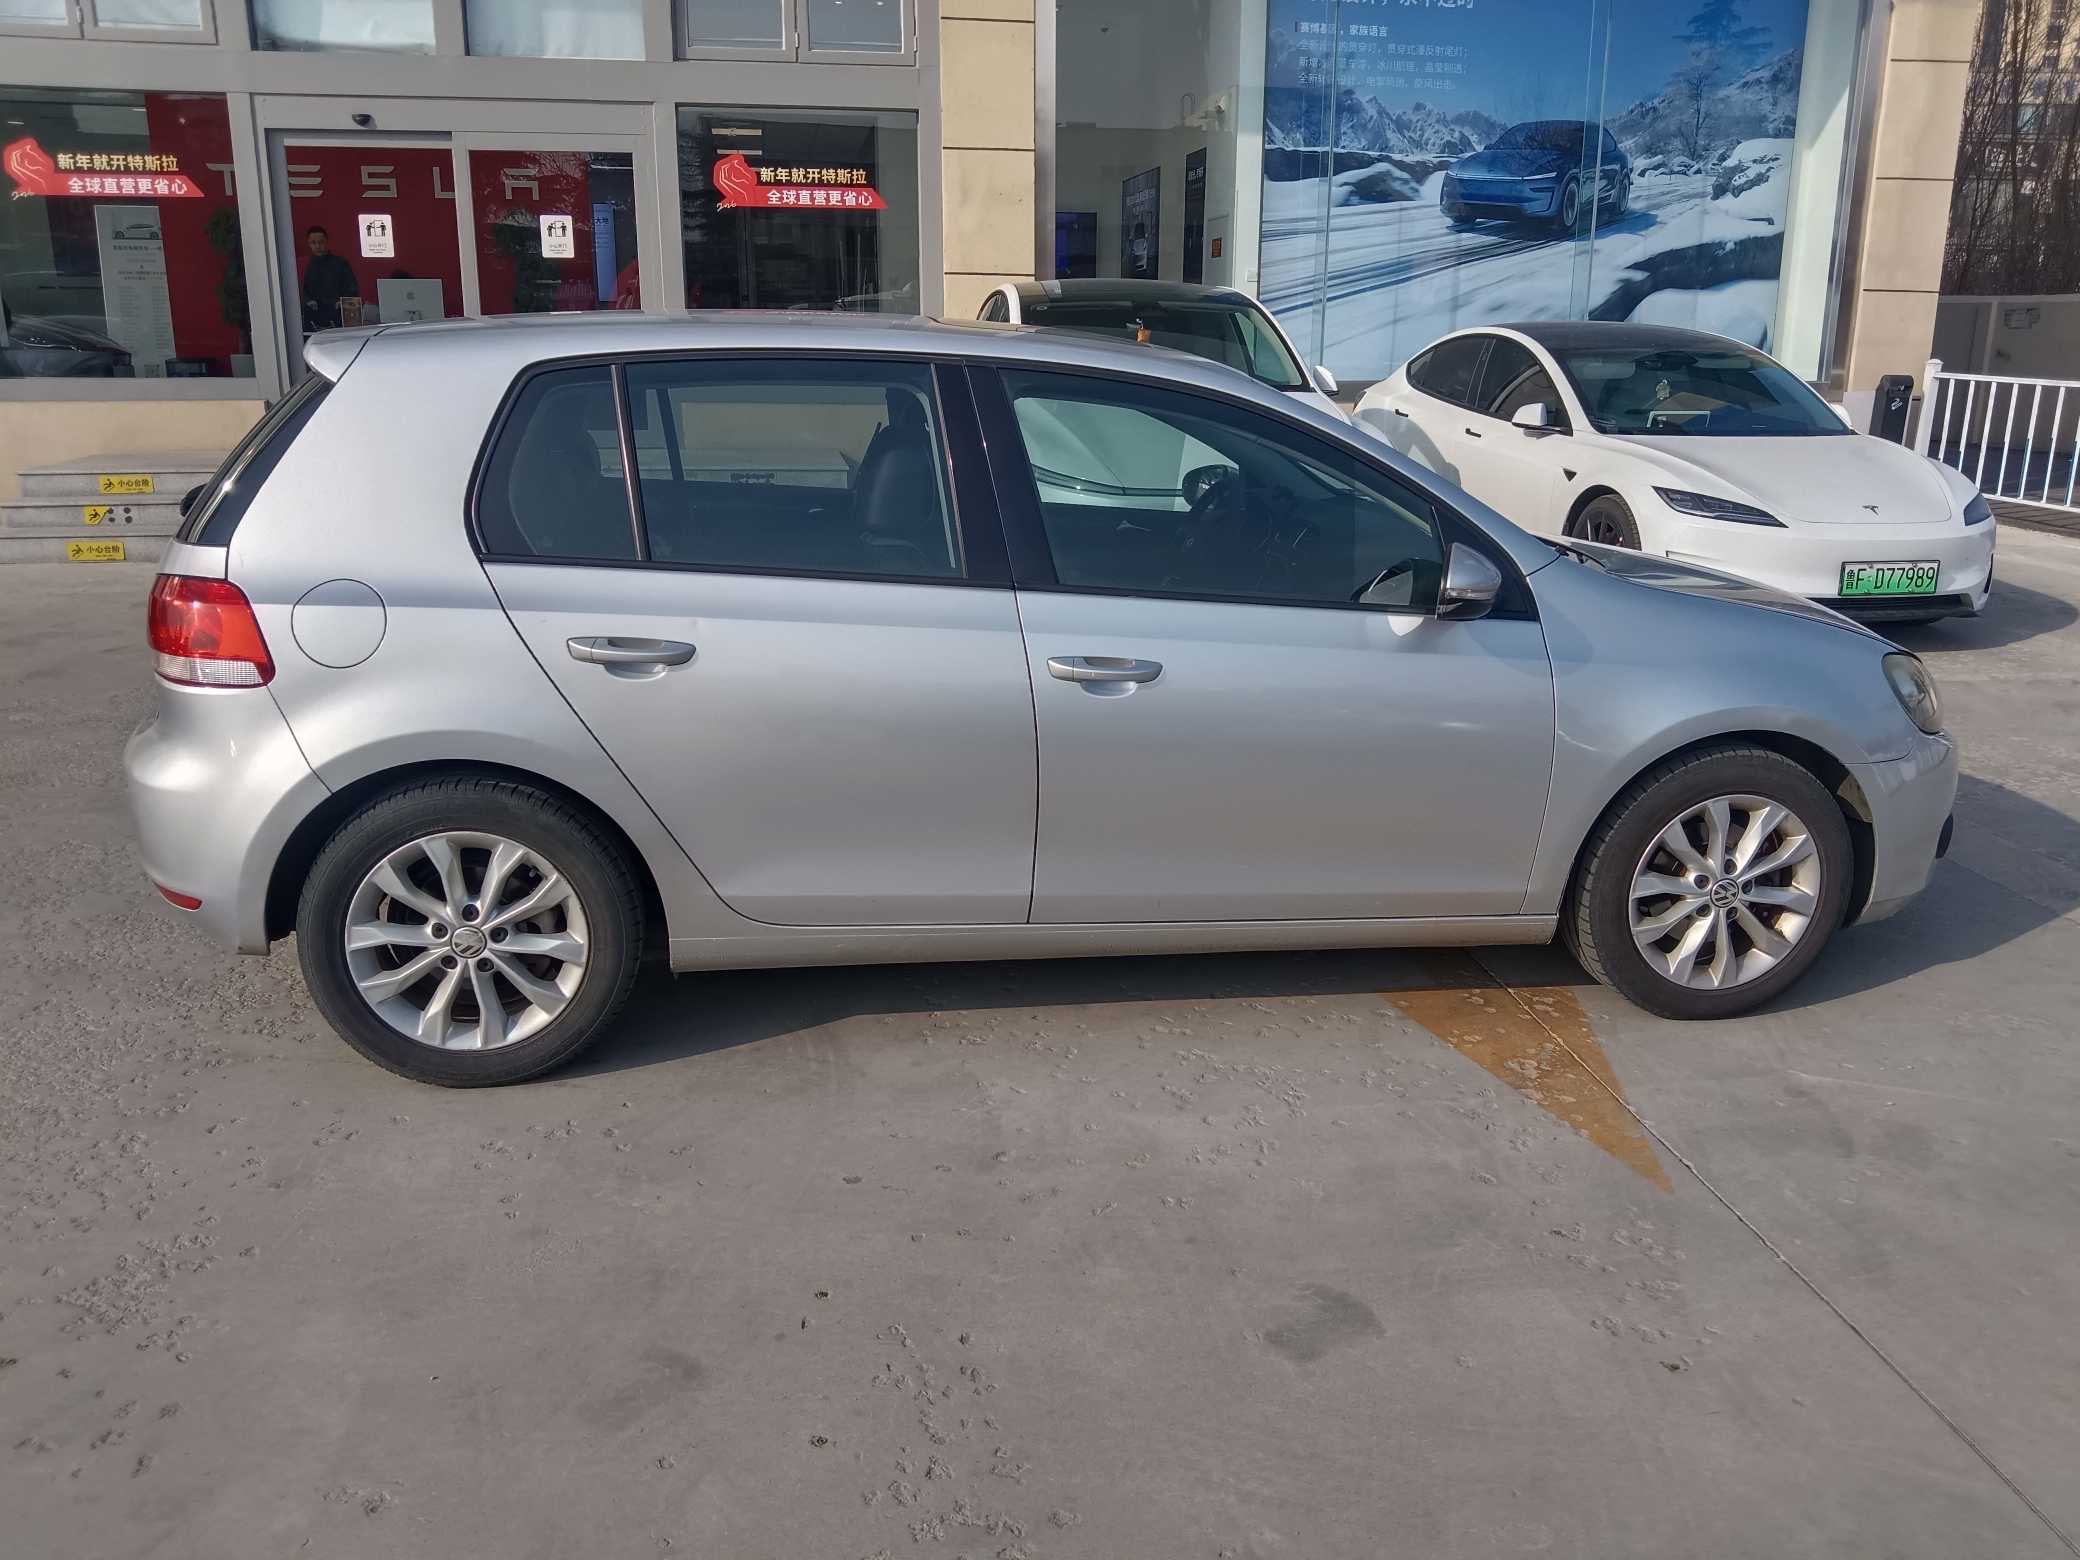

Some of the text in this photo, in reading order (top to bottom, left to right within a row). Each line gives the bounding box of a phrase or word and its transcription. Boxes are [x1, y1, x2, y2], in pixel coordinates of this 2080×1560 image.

[57, 153, 179, 171] 新年就开特斯拉
[206, 163, 540, 201] TESLA
[759, 167, 867, 185] 新年就开特斯拉
[68, 177, 187, 195] 全球直营更省心
[767, 190, 873, 206] 全球直营更省心
[117, 479, 149, 488] 小心台阶
[86, 545, 120, 554] 小心台阶
